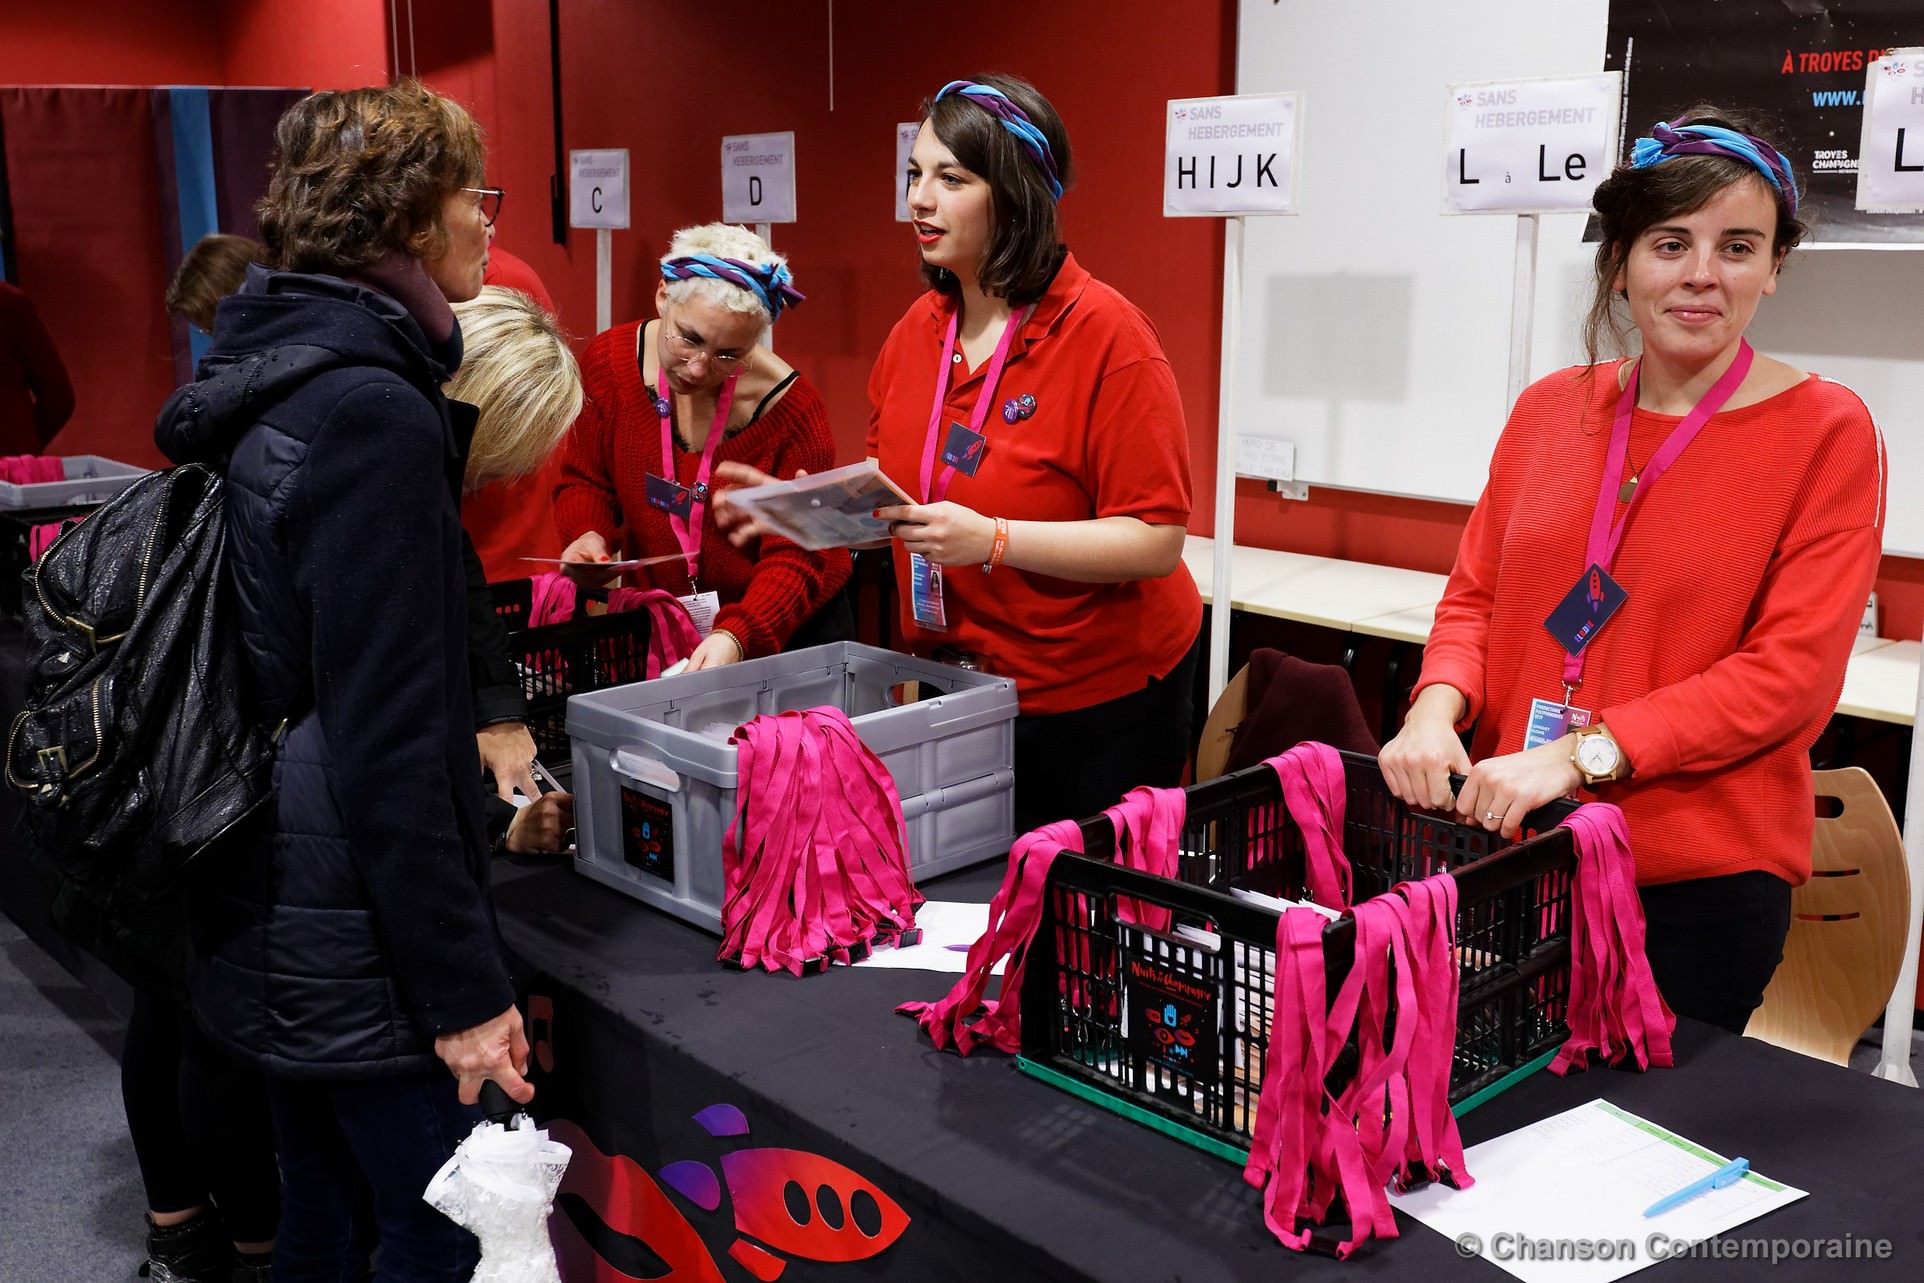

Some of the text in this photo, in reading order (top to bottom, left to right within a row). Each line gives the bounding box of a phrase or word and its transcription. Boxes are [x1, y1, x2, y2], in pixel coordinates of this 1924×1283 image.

[1781, 49, 1794, 74] À
[1798, 50, 1864, 73] TROYES
[1477, 90, 1517, 107] SANS
[1189, 106, 1222, 120] SANS
[1474, 107, 1596, 129] HEBERGEMENT
[1188, 122, 1284, 140] HEBERGEMENT
[1459, 148, 1480, 185] L
[1538, 144, 1587, 182] Le
[1814, 150, 1848, 159] TROYES
[592, 186, 603, 214] C
[749, 176, 762, 206] D
[1131, 960, 1157, 981] Nuits
